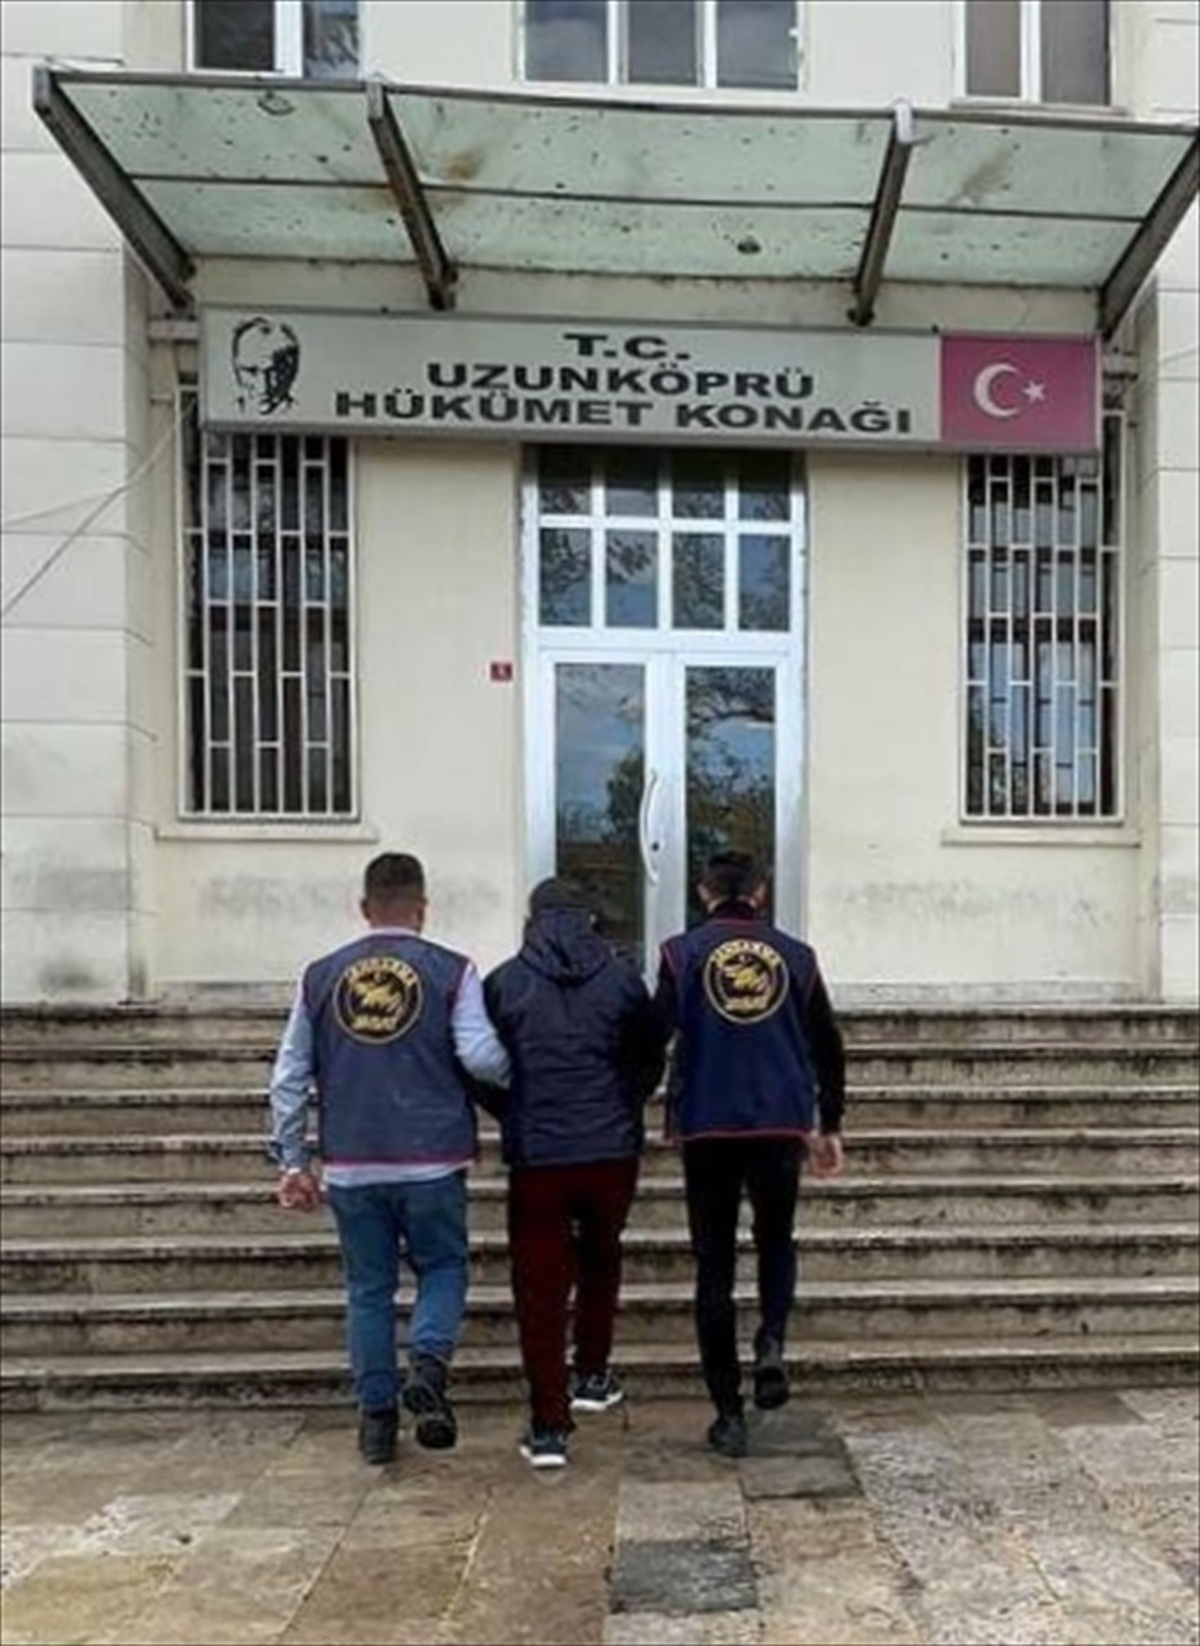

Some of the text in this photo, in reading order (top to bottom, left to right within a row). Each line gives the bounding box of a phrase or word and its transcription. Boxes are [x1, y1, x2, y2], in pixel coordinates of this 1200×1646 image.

[563, 333, 690, 360] T.C.
[427, 362, 814, 398] UZUNKÖPRÜ
[335, 388, 911, 433] HÜKÜMET KONAĞI
